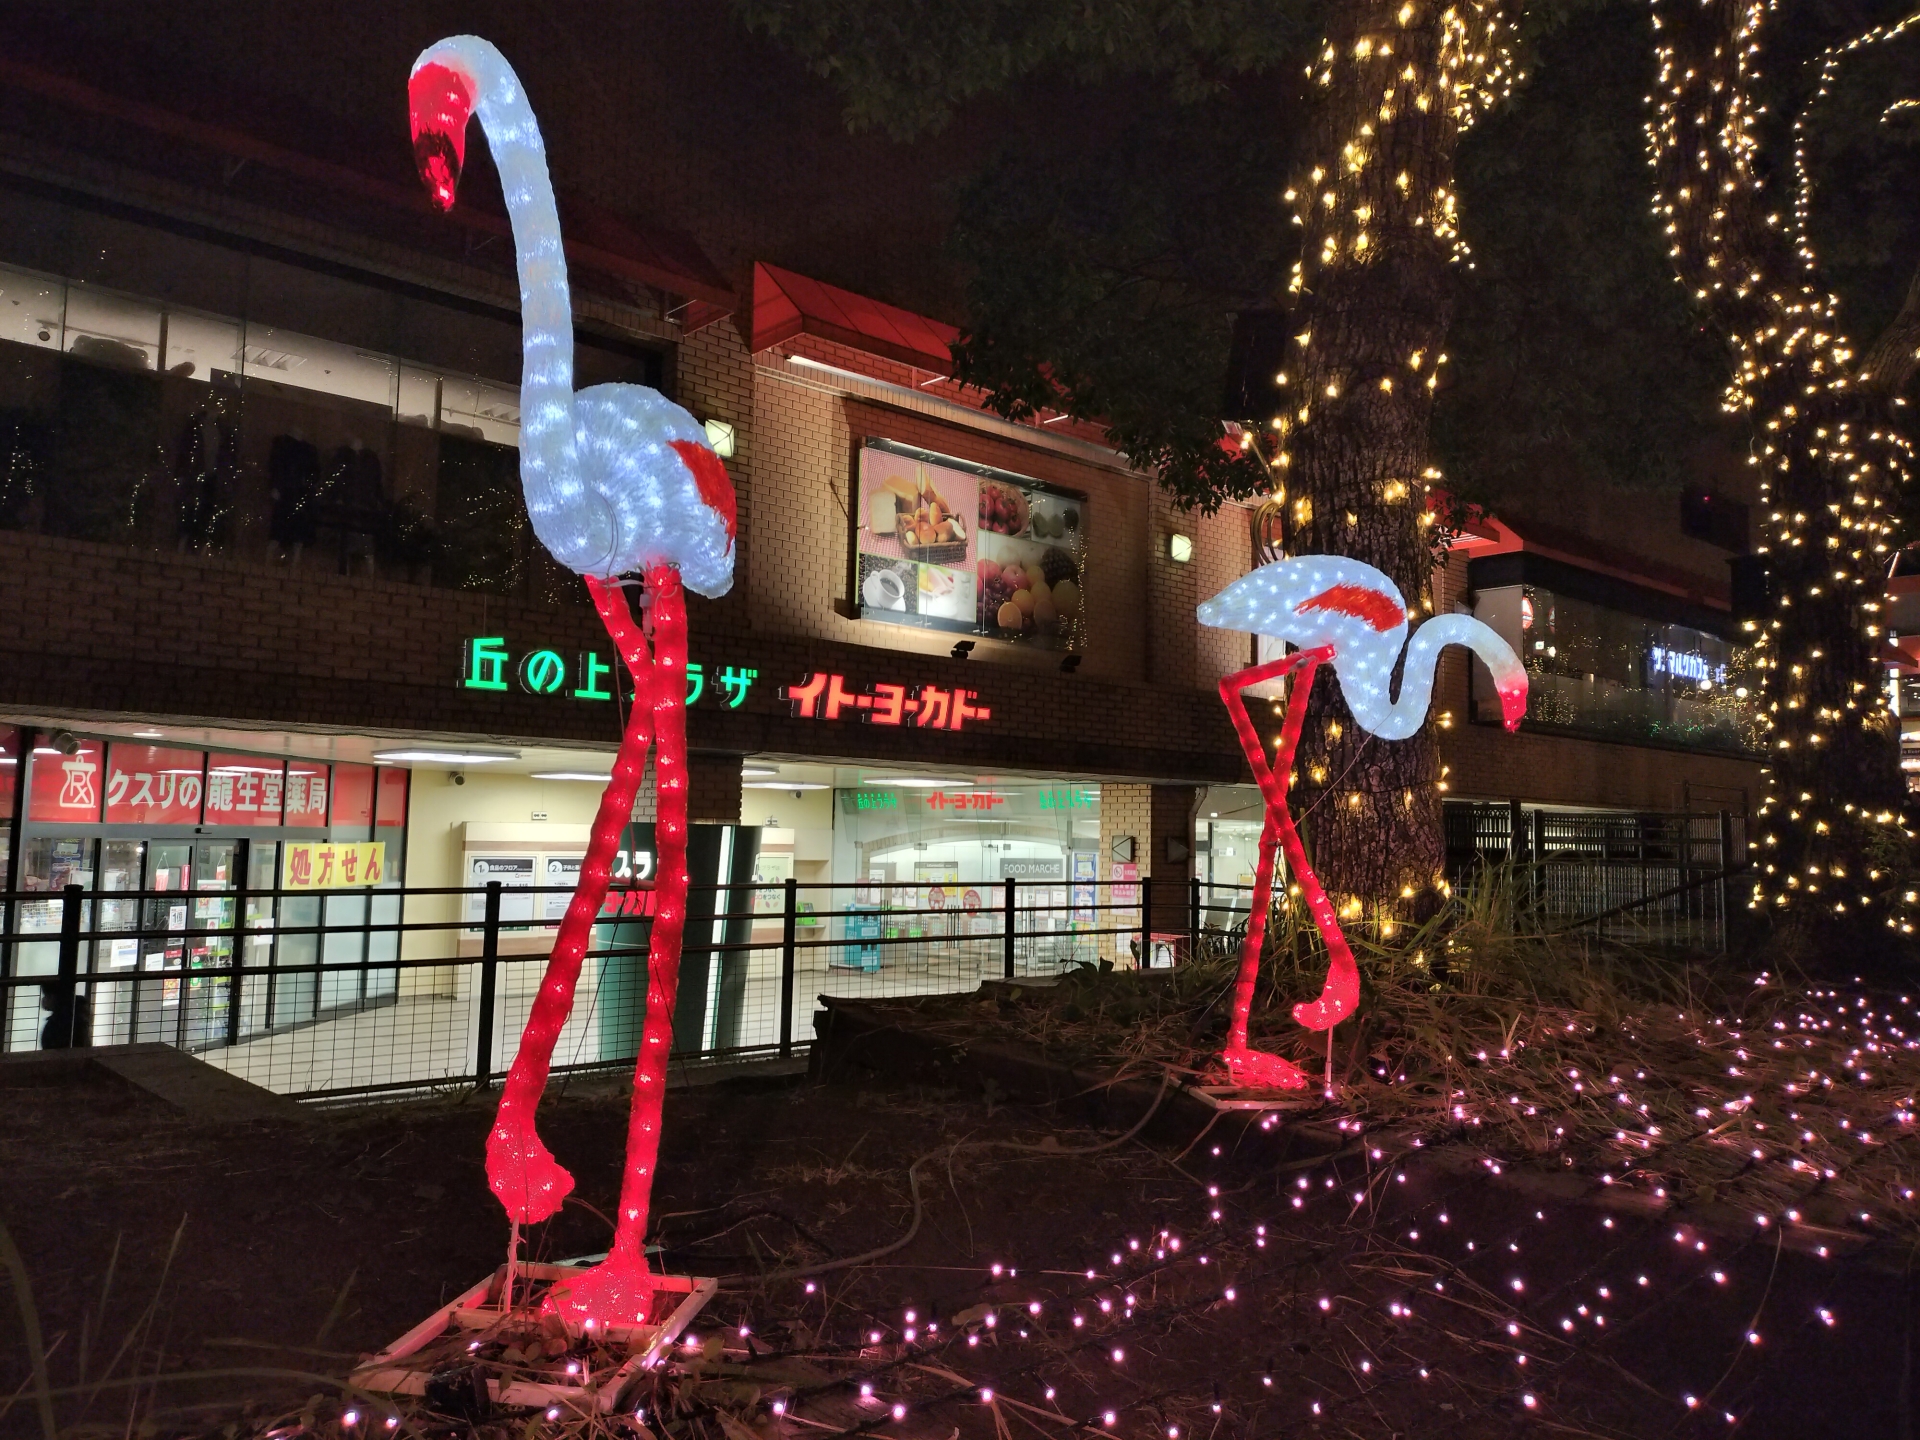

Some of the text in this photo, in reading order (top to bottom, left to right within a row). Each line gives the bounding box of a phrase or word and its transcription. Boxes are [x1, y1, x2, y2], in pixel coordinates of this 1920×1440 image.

[465, 637, 758, 708] 丘の上ラザ
[788, 673, 991, 730] イトーヨーカドー
[107, 769, 327, 816] クスリの龍生堂薬局
[291, 847, 381, 886] 処方せん
[1003, 863, 1061, 874] FOOD MARCHE
